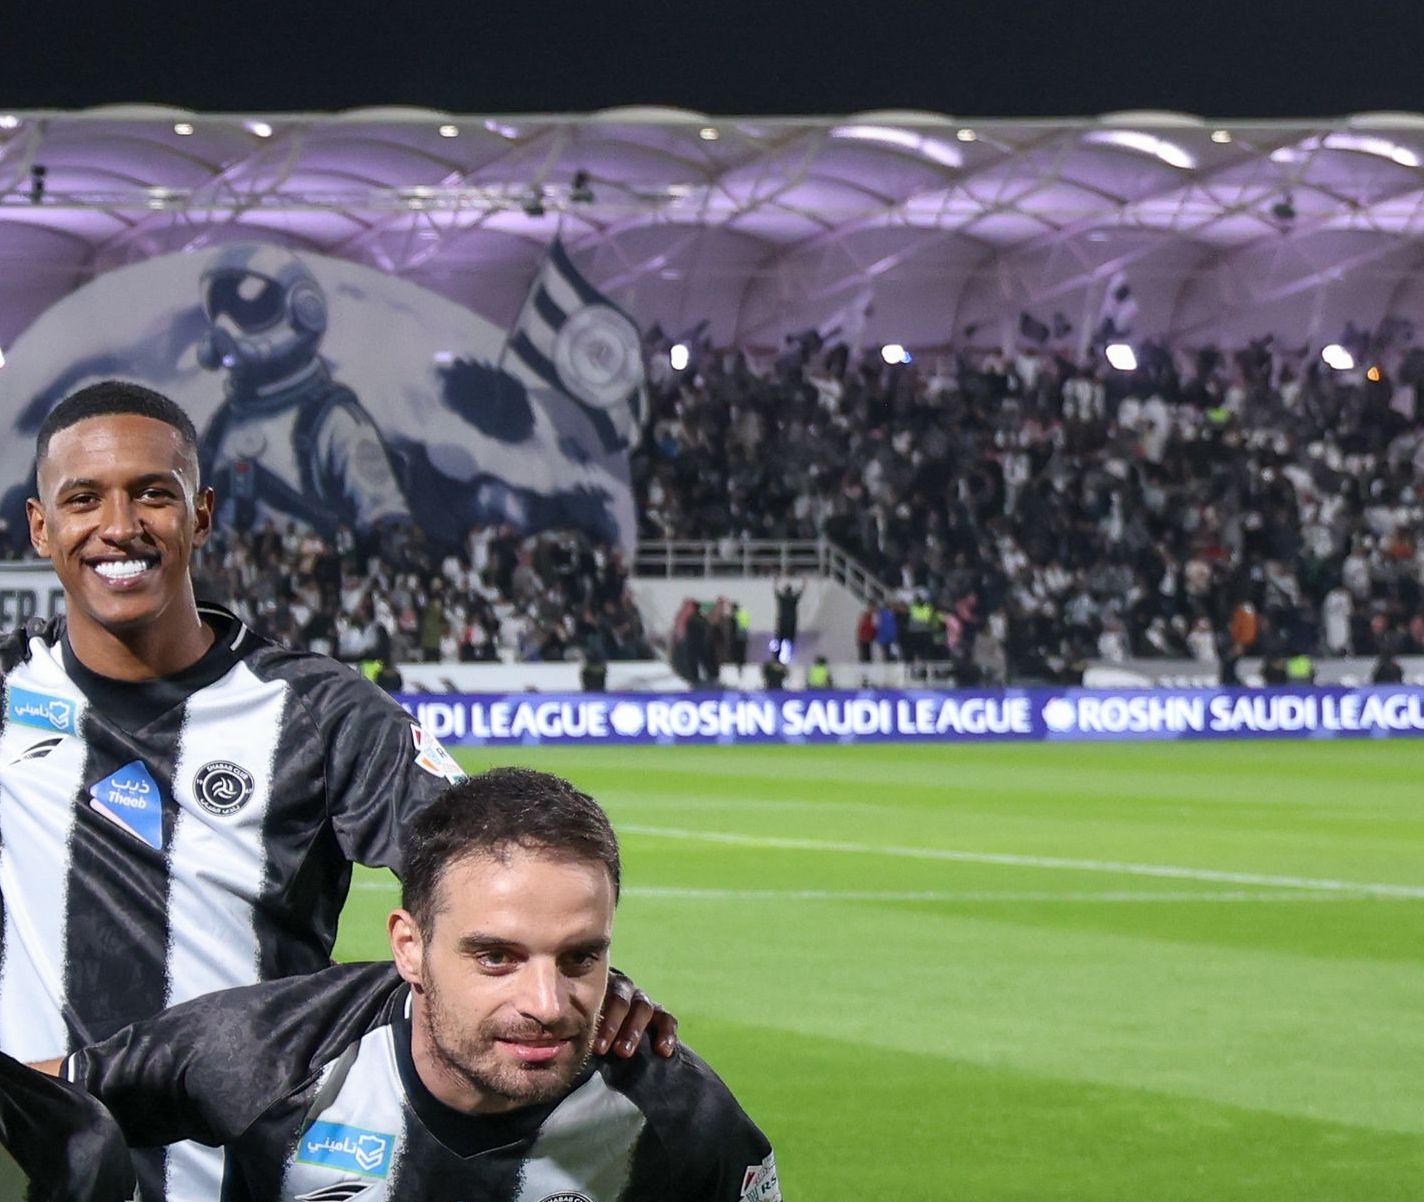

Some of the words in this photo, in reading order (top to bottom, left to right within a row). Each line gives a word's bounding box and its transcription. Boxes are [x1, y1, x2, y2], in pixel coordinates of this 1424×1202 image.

[471, 702, 608, 738] LEAGUE
[648, 701, 775, 736] ROSHN
[783, 699, 892, 735] SAUDI
[897, 698, 1032, 734] LEAGUE
[1078, 696, 1206, 732] ROSHN
[1210, 694, 1319, 731] SAUDI
[108, 790, 147, 809] Theeb
